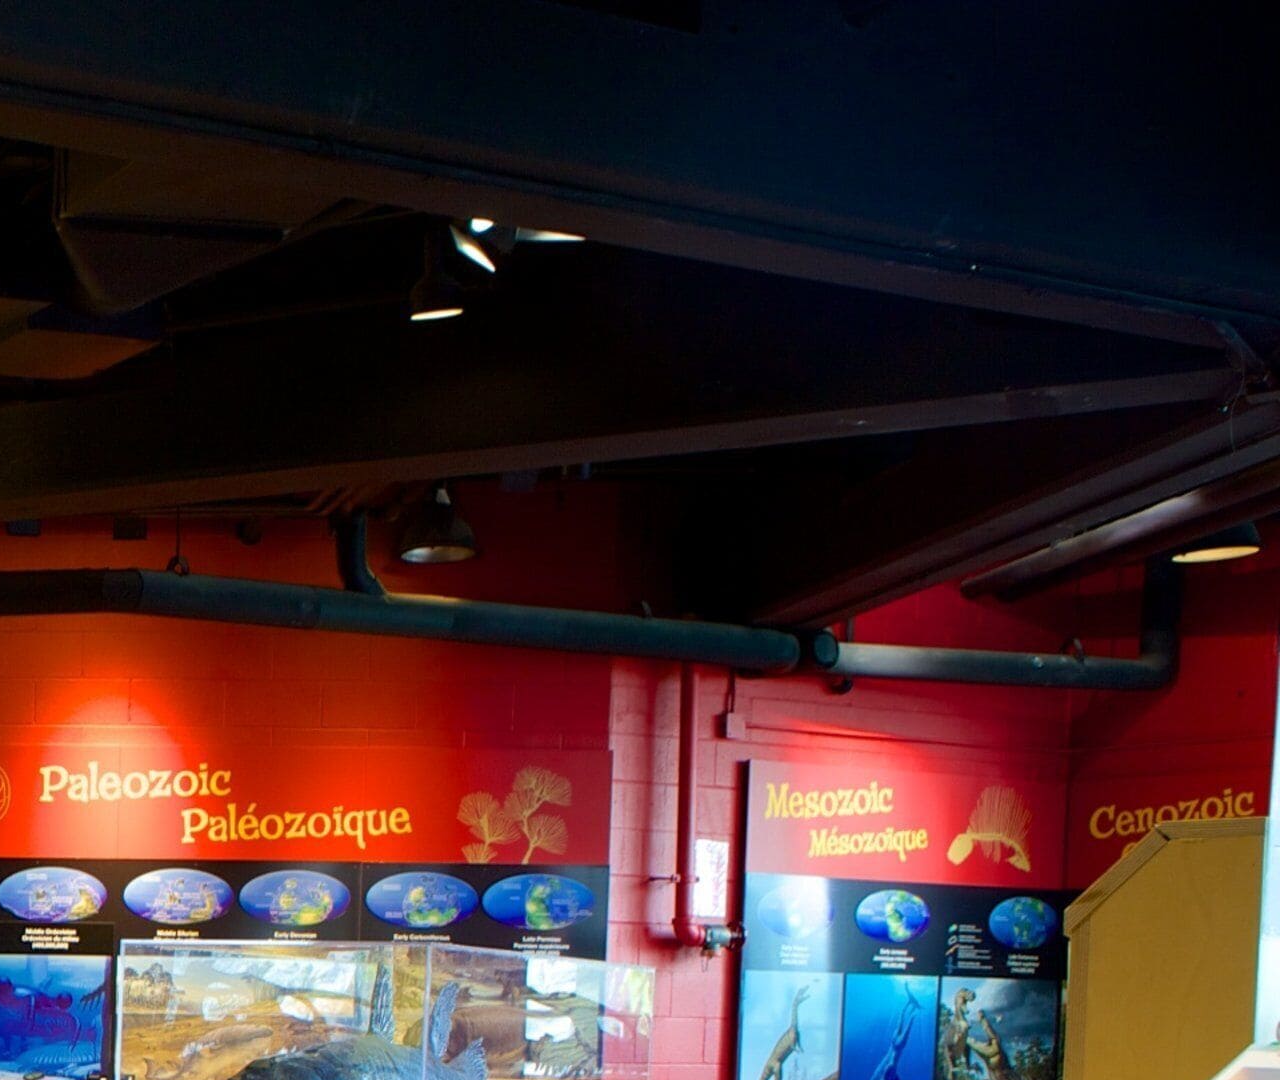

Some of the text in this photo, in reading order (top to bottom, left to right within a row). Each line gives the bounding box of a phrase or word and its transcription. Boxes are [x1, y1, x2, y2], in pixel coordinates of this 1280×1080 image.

[39, 760, 231, 803] Paleozoic
[765, 781, 894, 820] Mesozoic
[181, 803, 412, 850] Paléozoïque
[1089, 788, 1255, 839] Cenozoic
[808, 826, 929, 862] Mésozoïque
